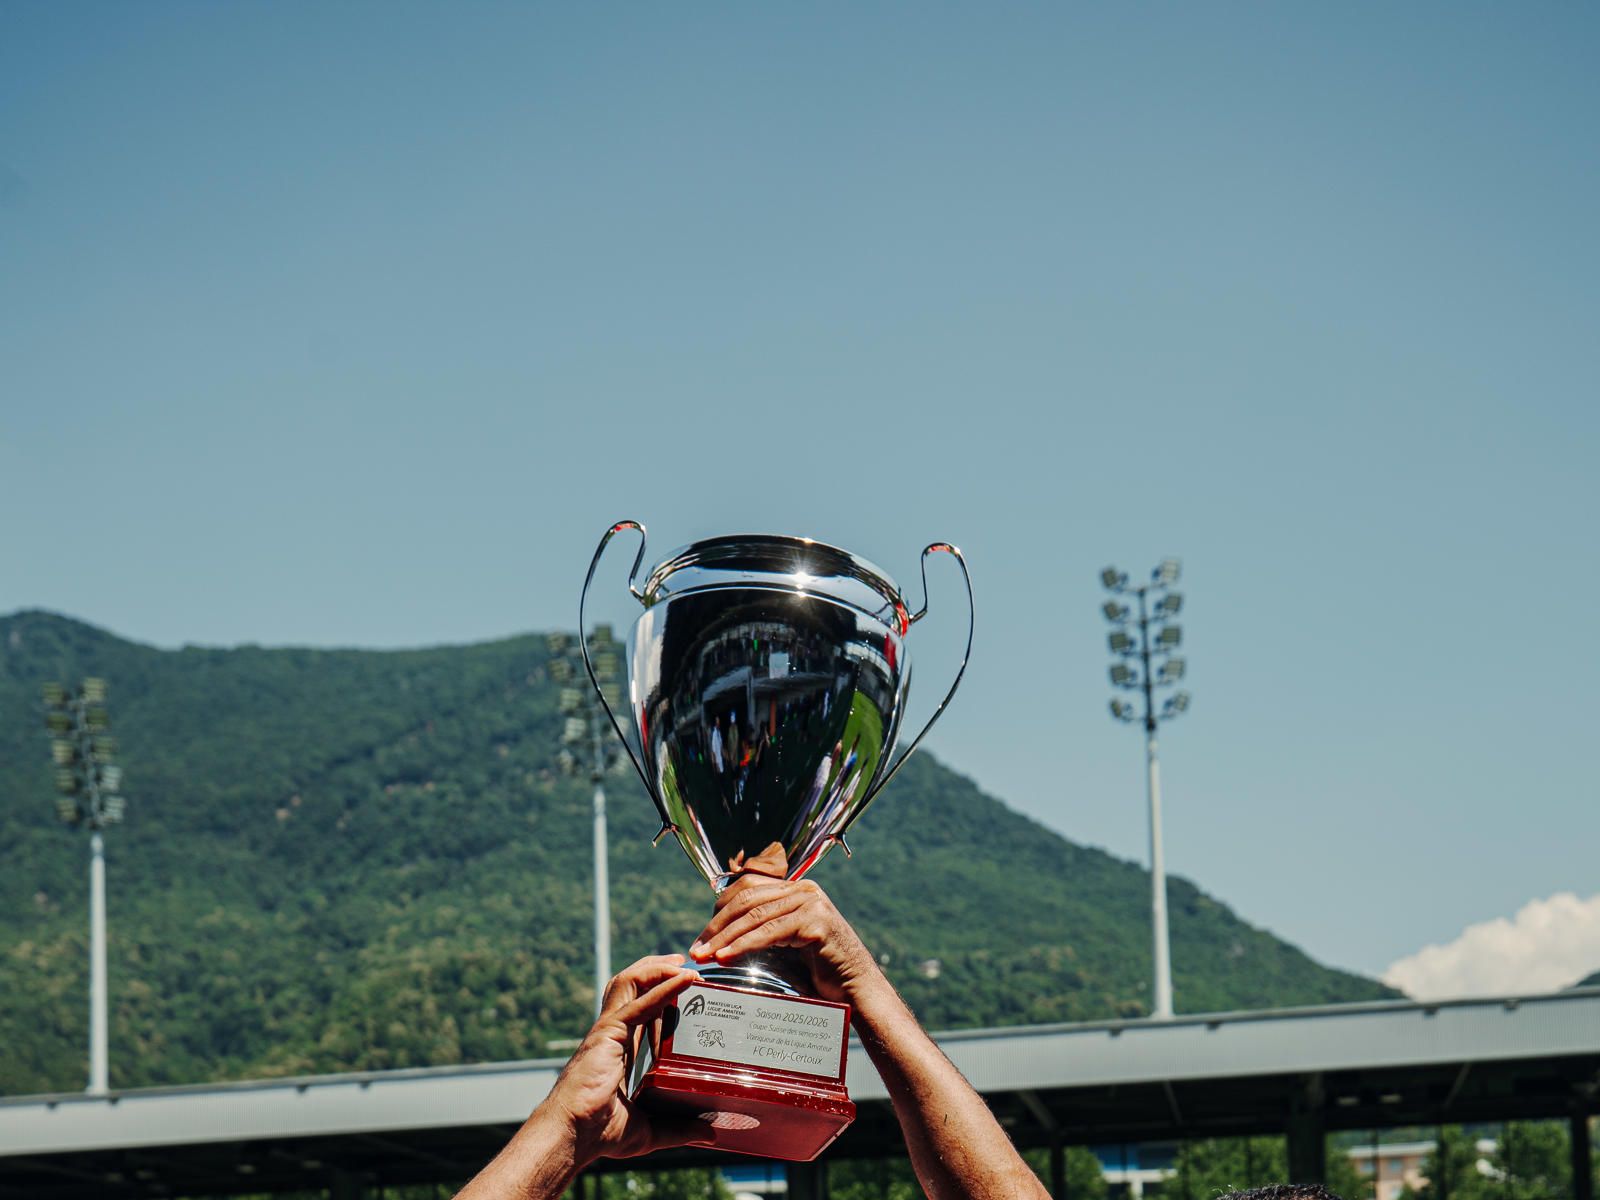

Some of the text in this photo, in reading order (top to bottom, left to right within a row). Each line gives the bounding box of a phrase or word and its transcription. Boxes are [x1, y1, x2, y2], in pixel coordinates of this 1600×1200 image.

[706, 1000, 731, 1008] AMATEUR
[755, 1008, 829, 1028] Saison 2025/2026
